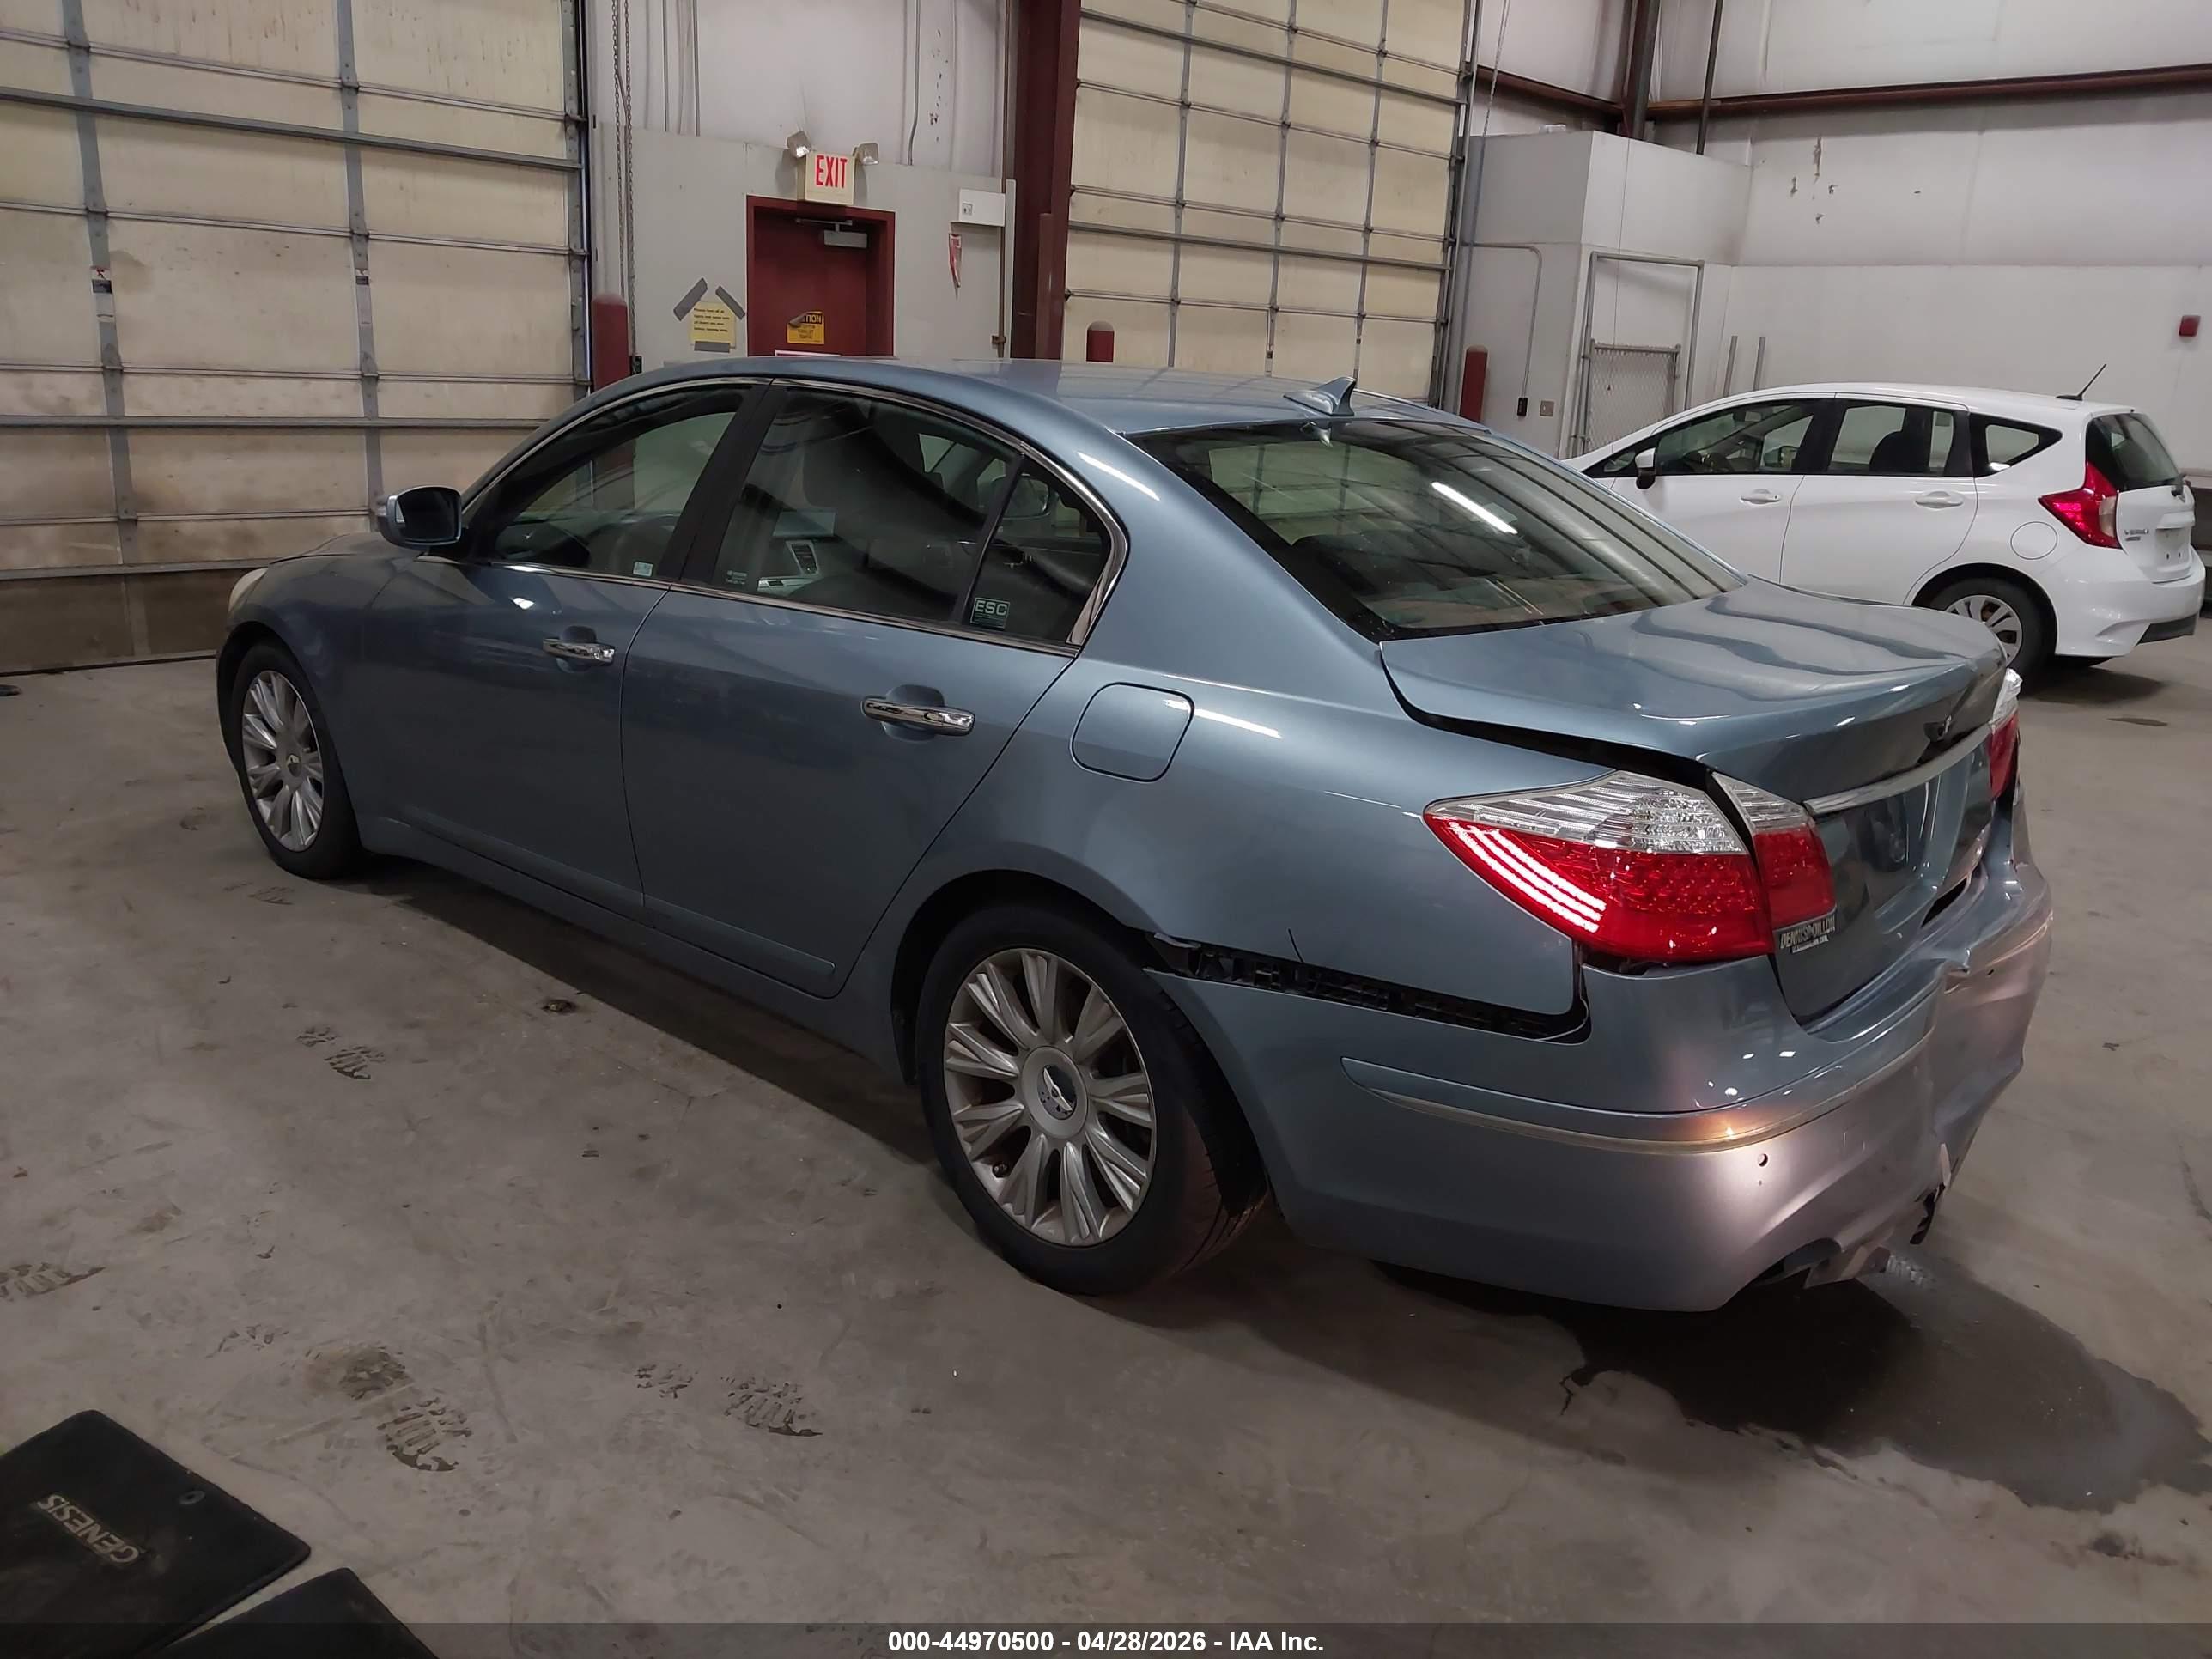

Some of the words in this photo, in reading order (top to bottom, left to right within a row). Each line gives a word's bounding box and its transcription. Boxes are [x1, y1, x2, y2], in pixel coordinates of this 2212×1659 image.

[816, 155, 848, 188] EXIT
[975, 599, 1008, 616] ESC
[37, 1494, 139, 1563] GENESIS
